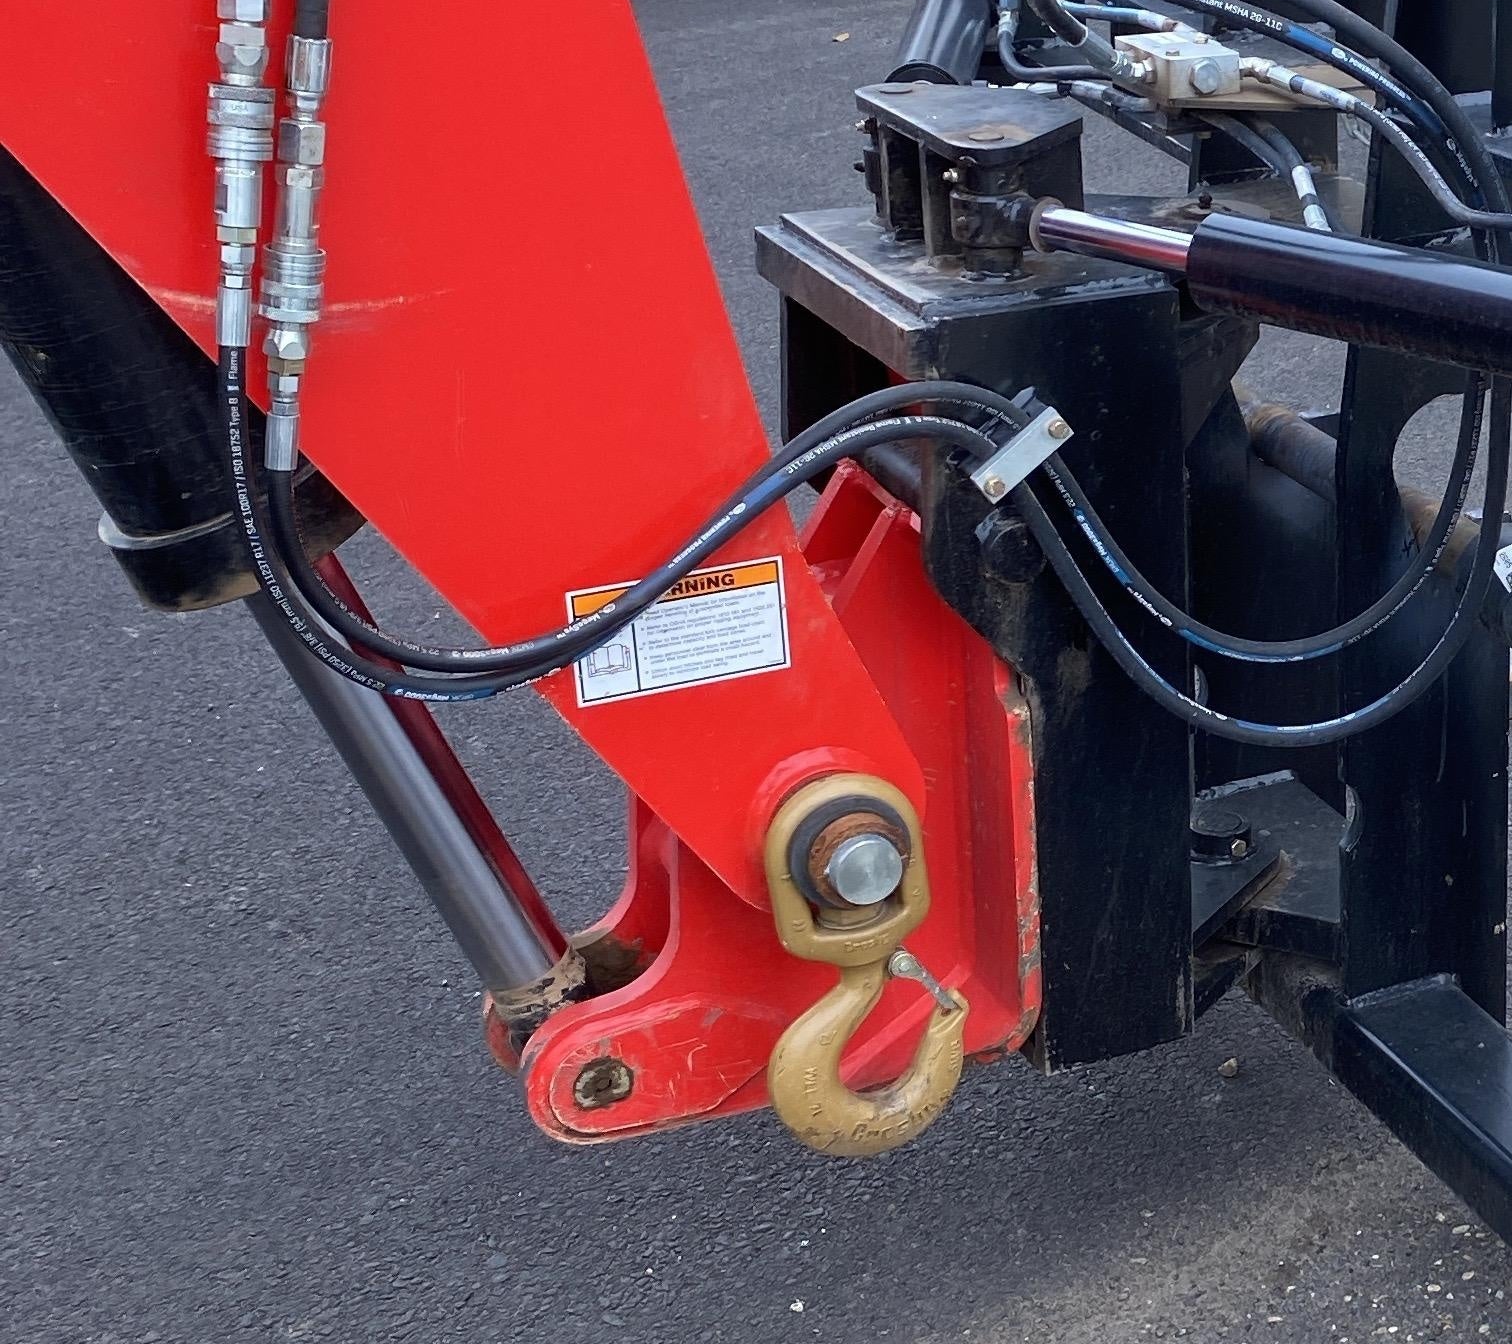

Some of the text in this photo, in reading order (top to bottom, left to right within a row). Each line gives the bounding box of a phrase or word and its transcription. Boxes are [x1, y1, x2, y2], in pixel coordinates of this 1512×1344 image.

[1224, 1, 1250, 18] MSHA
[228, 350, 238, 380] Flame
[229, 407, 241, 428] Type
[230, 428, 242, 457] 18752
[233, 458, 244, 475] ISO
[235, 482, 251, 516] 100R17
[243, 517, 257, 536] SAE
[664, 573, 736, 597] RNING
